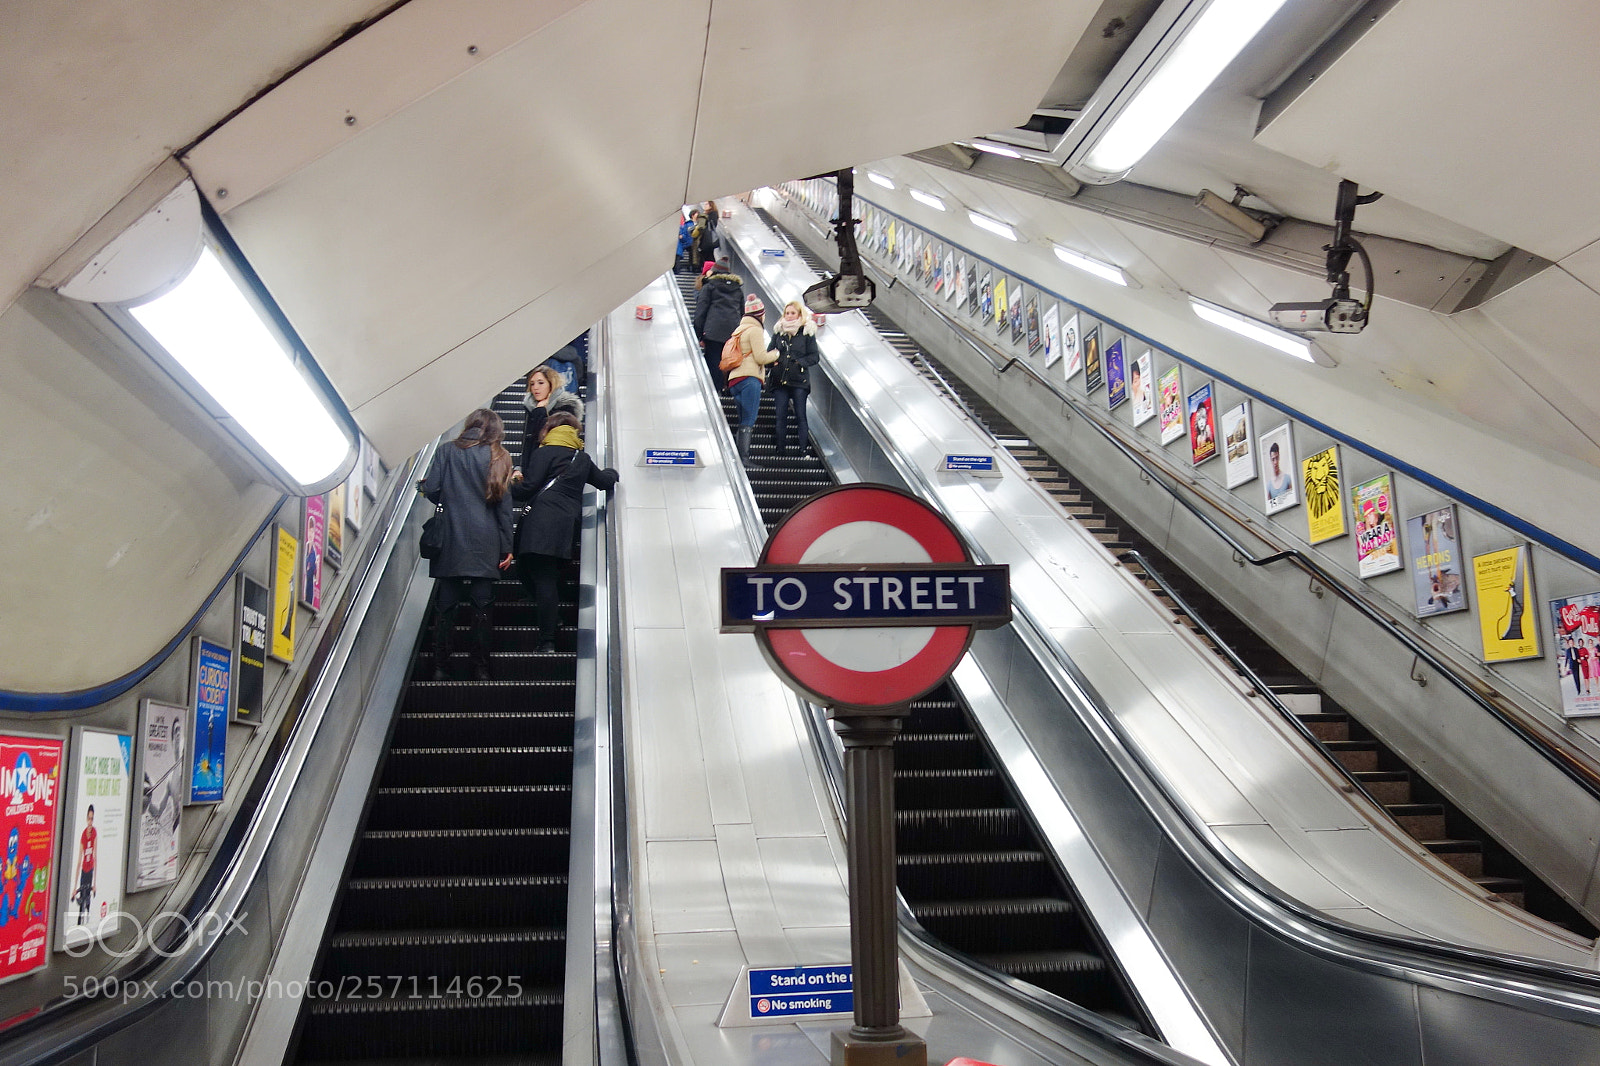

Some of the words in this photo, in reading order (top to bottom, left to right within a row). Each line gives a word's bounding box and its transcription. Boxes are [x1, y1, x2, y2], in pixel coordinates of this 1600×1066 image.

[1360, 526, 1382, 543] WEAR
[1384, 522, 1390, 532] A
[1361, 539, 1376, 554] HAT
[1377, 532, 1391, 546] DAY
[1416, 549, 1452, 570] HERONS
[747, 577, 807, 611] TO
[833, 577, 984, 611] STREET
[200, 665, 229, 690] CURIOUS
[199, 686, 227, 705] INCIDENT
[771, 973, 805, 987] Stand
[808, 975, 824, 985] on
[826, 973, 847, 984] the
[772, 999, 787, 1010] No
[789, 997, 832, 1009] smoking
